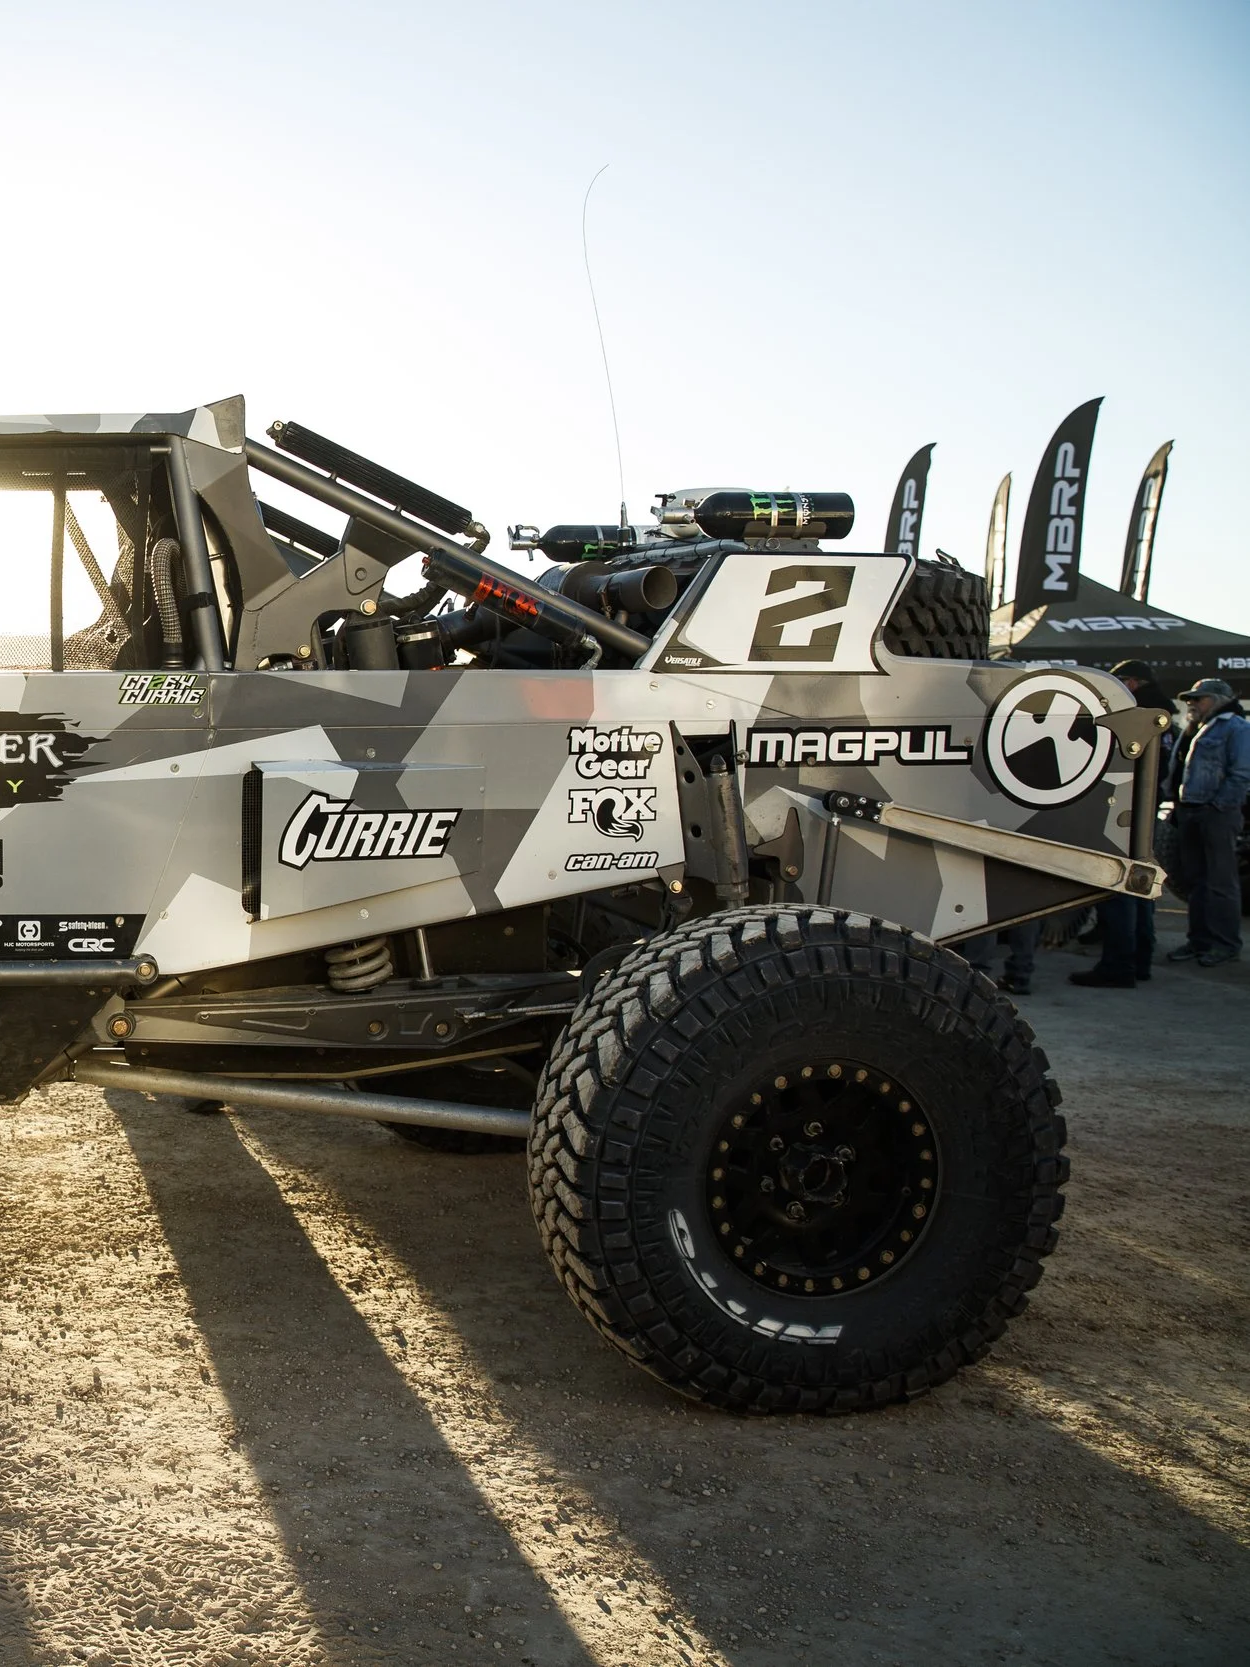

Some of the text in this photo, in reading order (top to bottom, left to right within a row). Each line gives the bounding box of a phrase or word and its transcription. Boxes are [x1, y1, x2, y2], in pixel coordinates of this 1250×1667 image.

[897, 478, 918, 553] RP
[1043, 442, 1081, 591] MBRP
[748, 565, 856, 662] 2
[1046, 616, 1186, 632] MBRP
[120, 689, 205, 704] CURRIE
[570, 728, 661, 752] Motive
[751, 731, 968, 762] MAGPUL
[578, 753, 650, 778] Gear
[569, 787, 657, 842] FOX
[281, 793, 459, 868] CURRIE
[566, 853, 657, 870] can-am
[68, 938, 115, 952] CRC
